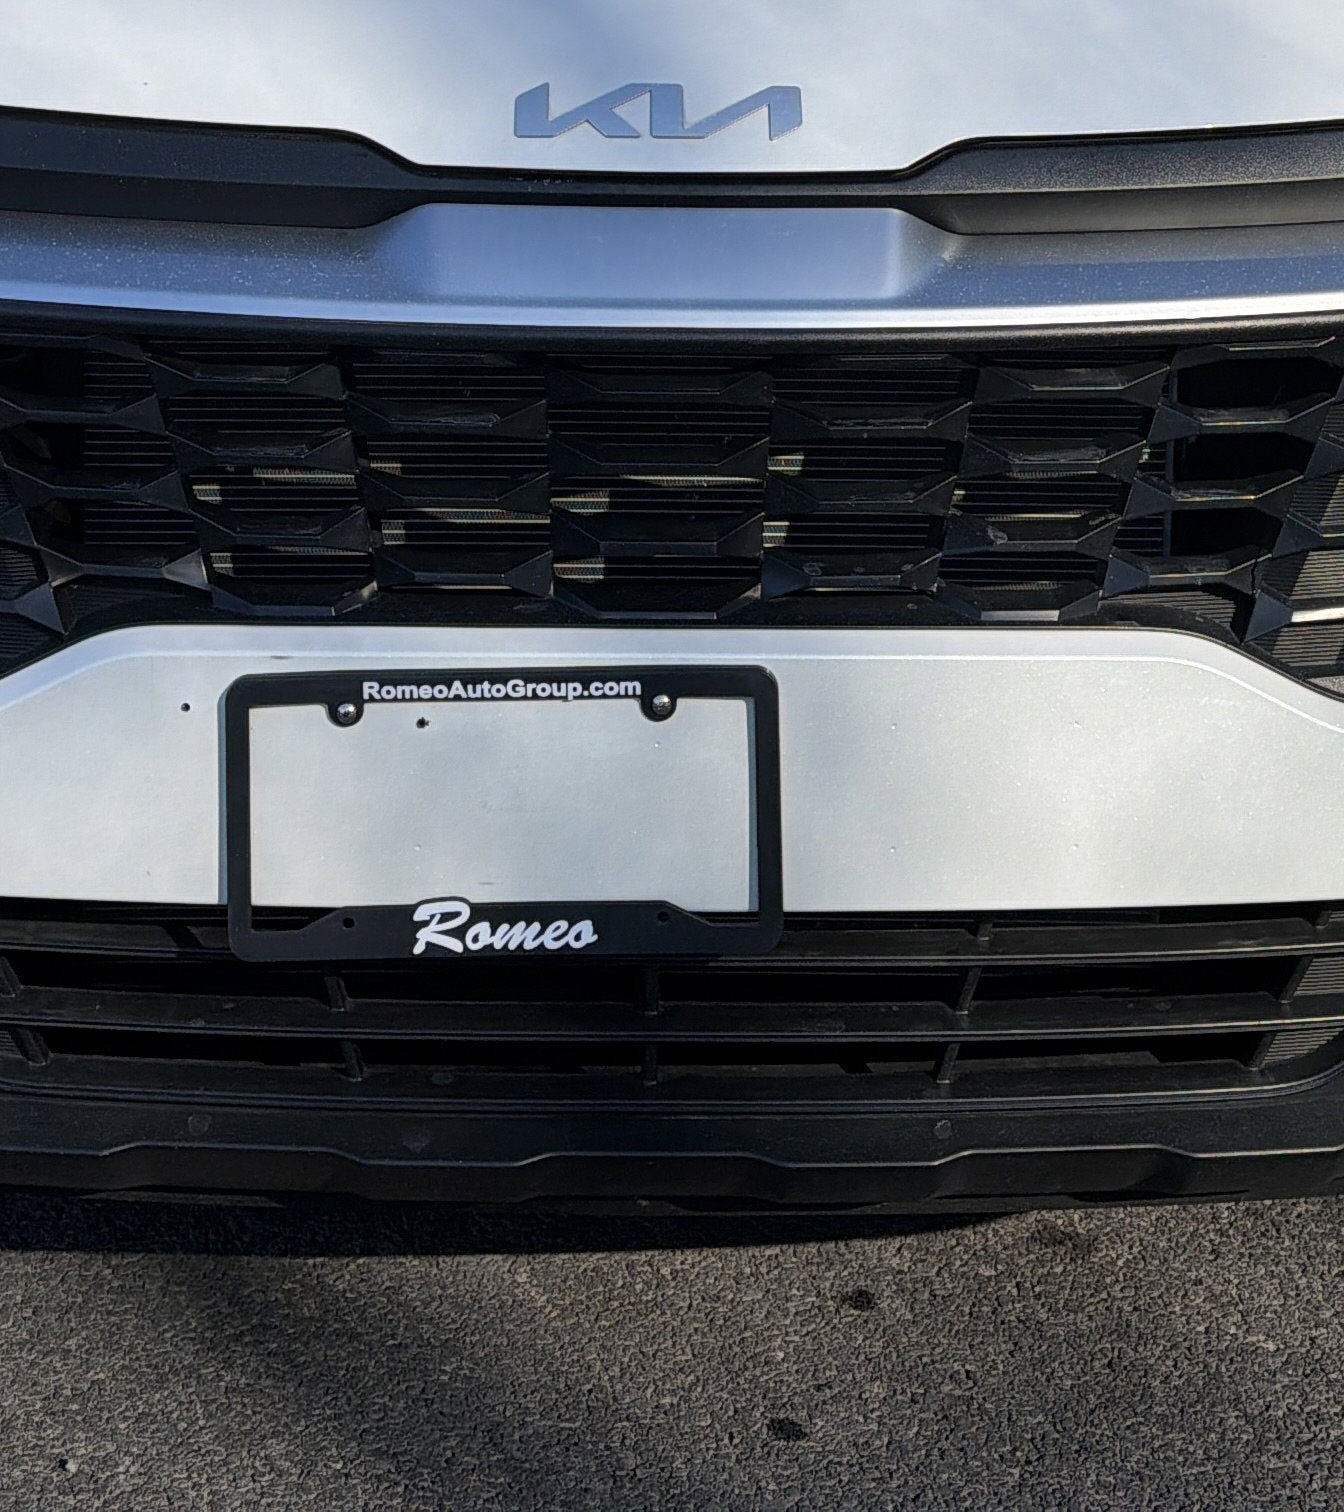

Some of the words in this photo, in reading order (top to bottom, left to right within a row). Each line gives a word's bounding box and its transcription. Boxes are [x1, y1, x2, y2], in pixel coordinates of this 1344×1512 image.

[514, 82, 803, 141] KIA
[362, 678, 642, 701] RomeoAutoGroup.com
[412, 900, 598, 955] Romeo
